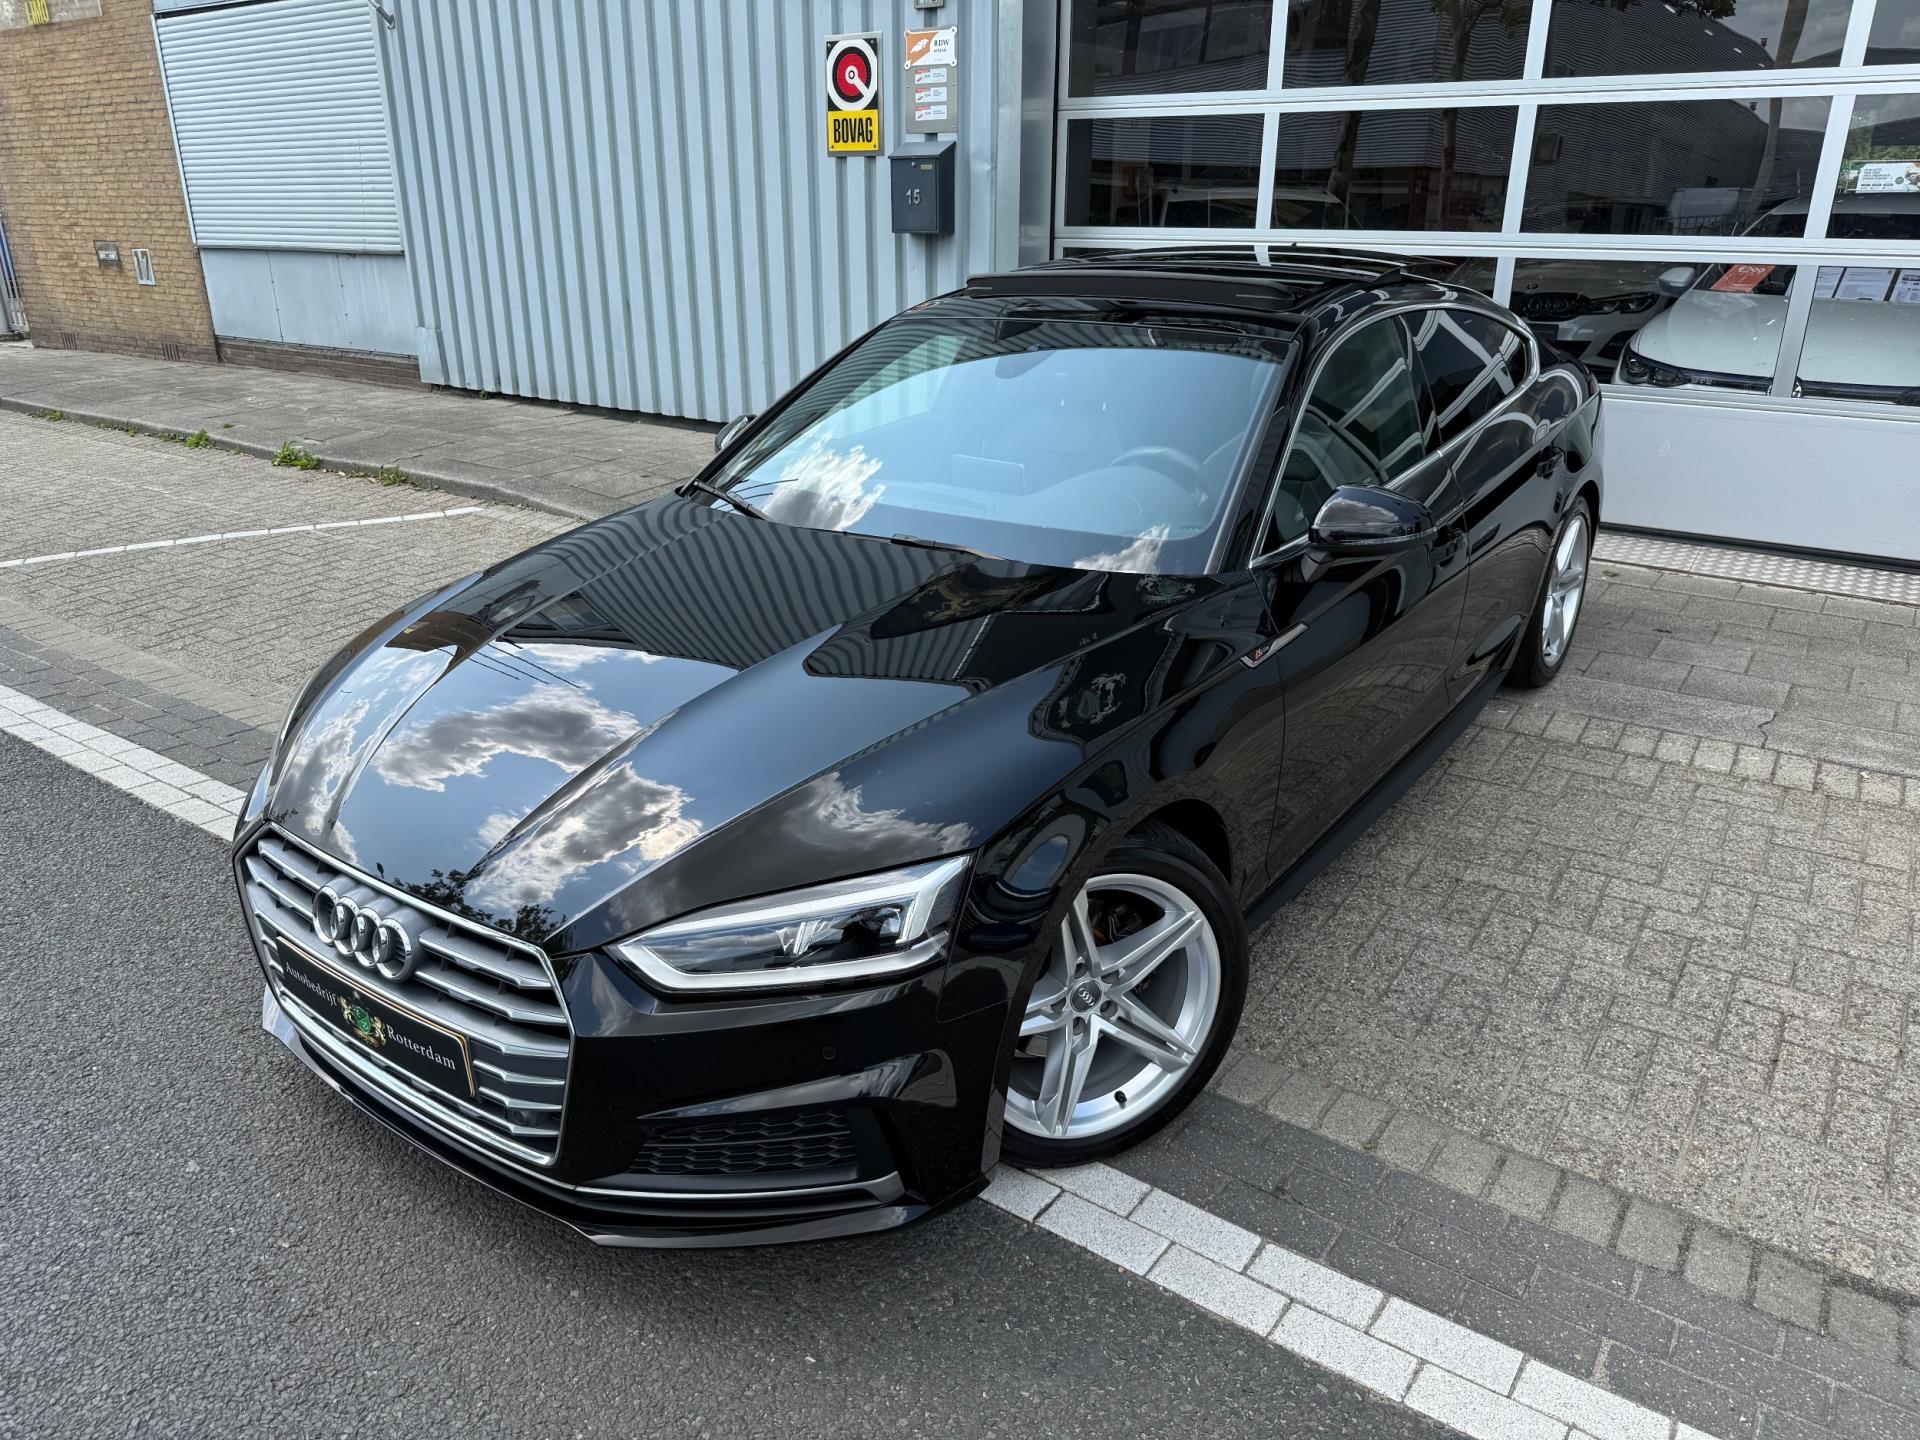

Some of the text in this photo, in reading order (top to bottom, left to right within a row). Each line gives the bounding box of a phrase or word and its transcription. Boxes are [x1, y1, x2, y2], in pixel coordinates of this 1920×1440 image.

[833, 117, 873, 144] BOVAG
[905, 188, 921, 205] 15
[286, 962, 457, 1071] Autobedrijf Rotterdam
